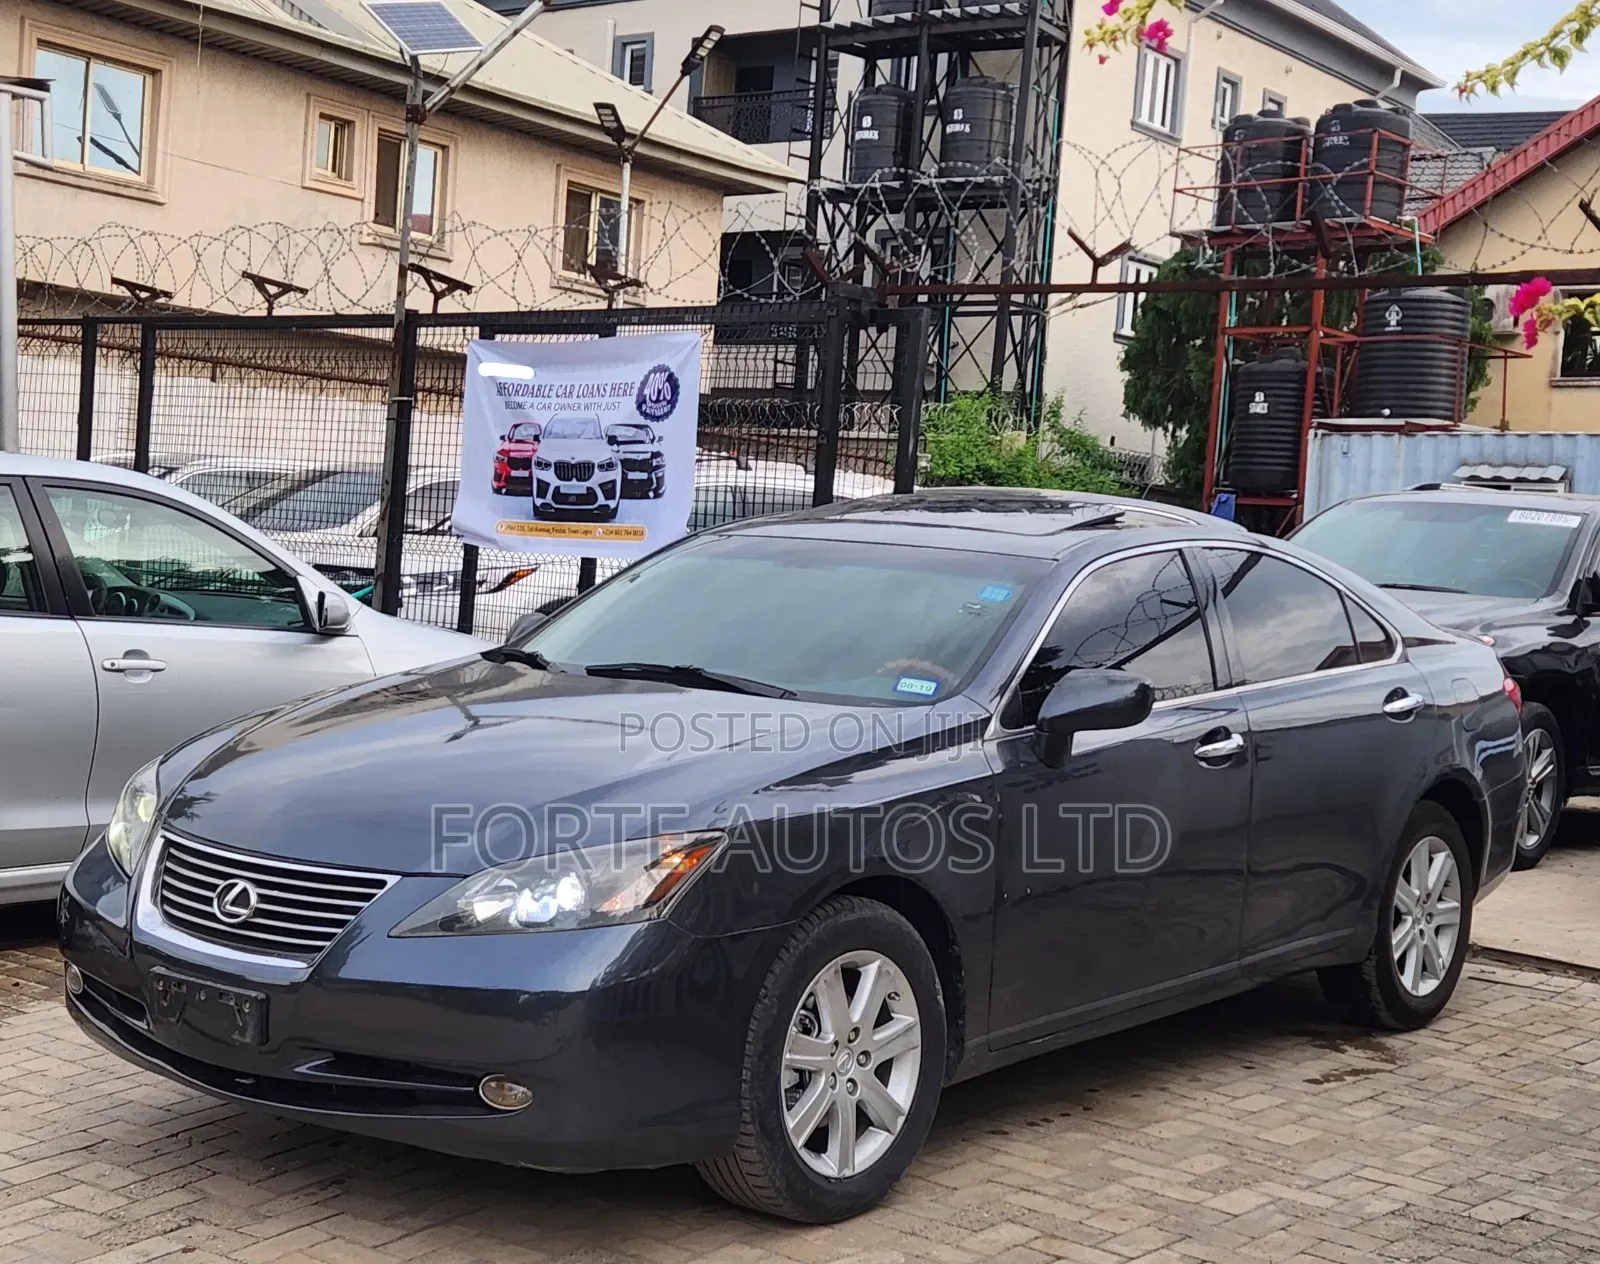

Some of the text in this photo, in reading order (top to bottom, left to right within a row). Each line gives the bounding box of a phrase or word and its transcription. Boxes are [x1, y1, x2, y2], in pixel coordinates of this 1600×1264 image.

[496, 381, 636, 399] AFFORDABLE CAR LOANS HERE
[643, 371, 672, 401] 40%
[504, 400, 621, 412] BECOME A CAR OWNER WITH JUST
[641, 403, 672, 416] PAYMENT
[900, 680, 933, 692] 08-19
